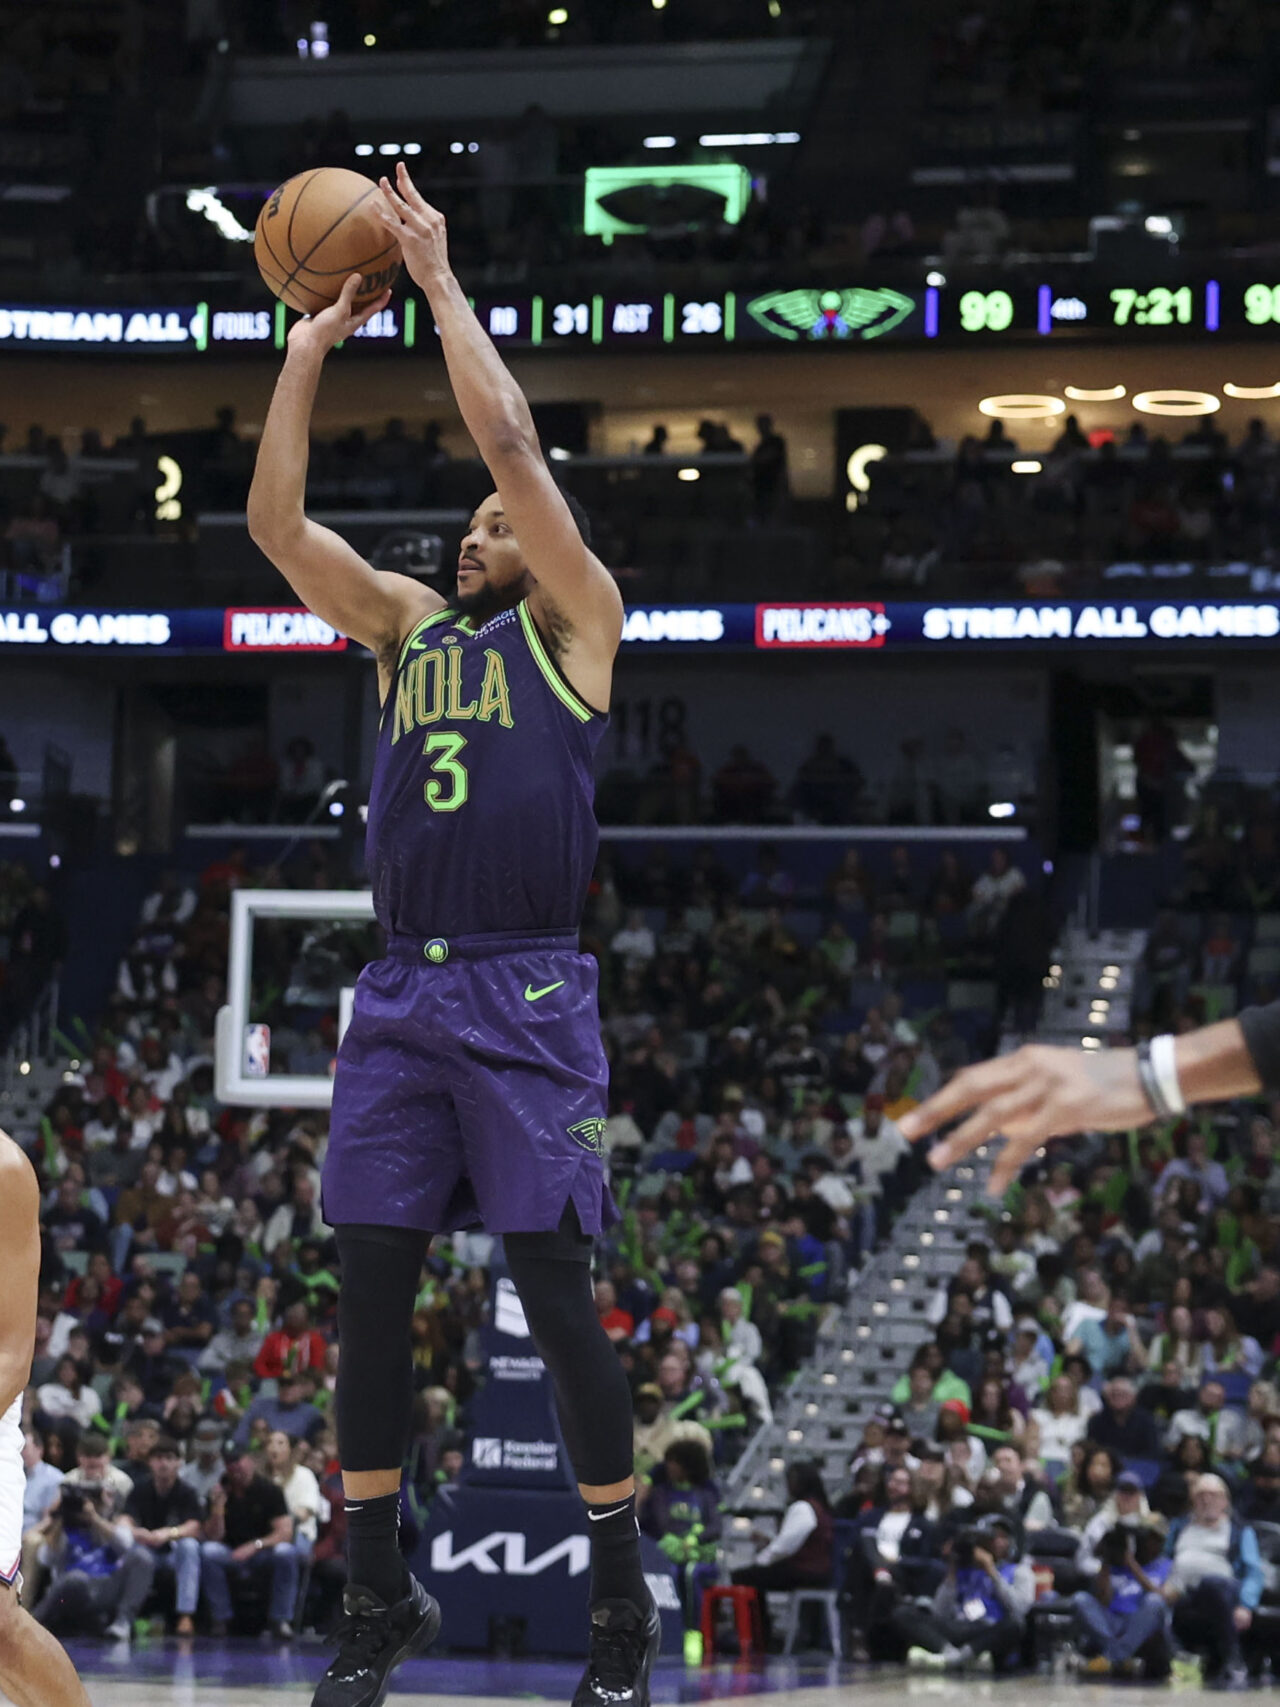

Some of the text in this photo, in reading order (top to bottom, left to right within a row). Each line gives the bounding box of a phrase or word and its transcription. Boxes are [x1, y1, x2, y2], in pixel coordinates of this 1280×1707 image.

[552, 303, 589, 335] 31
[682, 302, 722, 334] 26
[960, 290, 1014, 332] 99
[1109, 286, 1193, 326] 7:21
[124, 313, 189, 342] ALL
[212, 311, 271, 341] FOULS
[50, 613, 171, 646] GAMES
[230, 610, 347, 647] PELICANS
[621, 609, 725, 642] AMES
[762, 606, 891, 643] PELICANS+
[923, 604, 1280, 640] STREAM ALL GAMES
[392, 645, 515, 746] NOLA
[422, 730, 468, 812] 3
[430, 1530, 592, 1578] KIA
